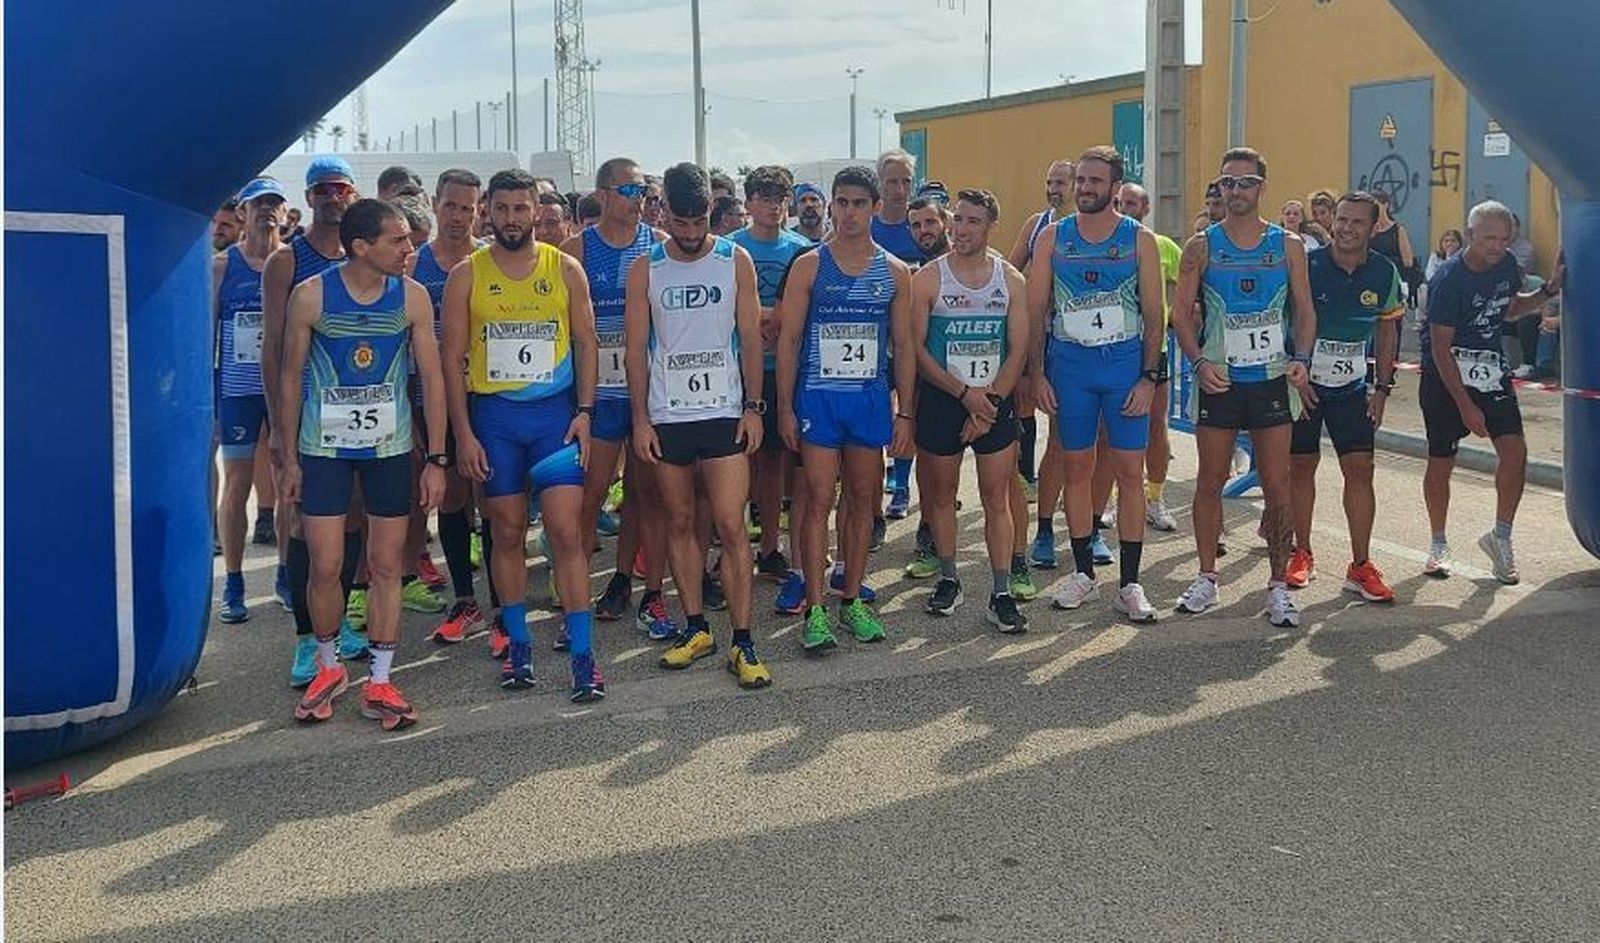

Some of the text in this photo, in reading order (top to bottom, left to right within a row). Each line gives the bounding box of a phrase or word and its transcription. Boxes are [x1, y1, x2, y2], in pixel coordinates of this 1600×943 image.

[944, 320, 1002, 335] ATLEET
[1091, 311, 1104, 329] 4
[1247, 330, 1271, 350] 15
[518, 344, 532, 365] 6
[841, 343, 866, 362] 24
[967, 360, 990, 378] 13
[1331, 360, 1354, 375] 58
[1468, 365, 1491, 381] 63
[687, 372, 711, 393] 61
[347, 408, 379, 430] 35
